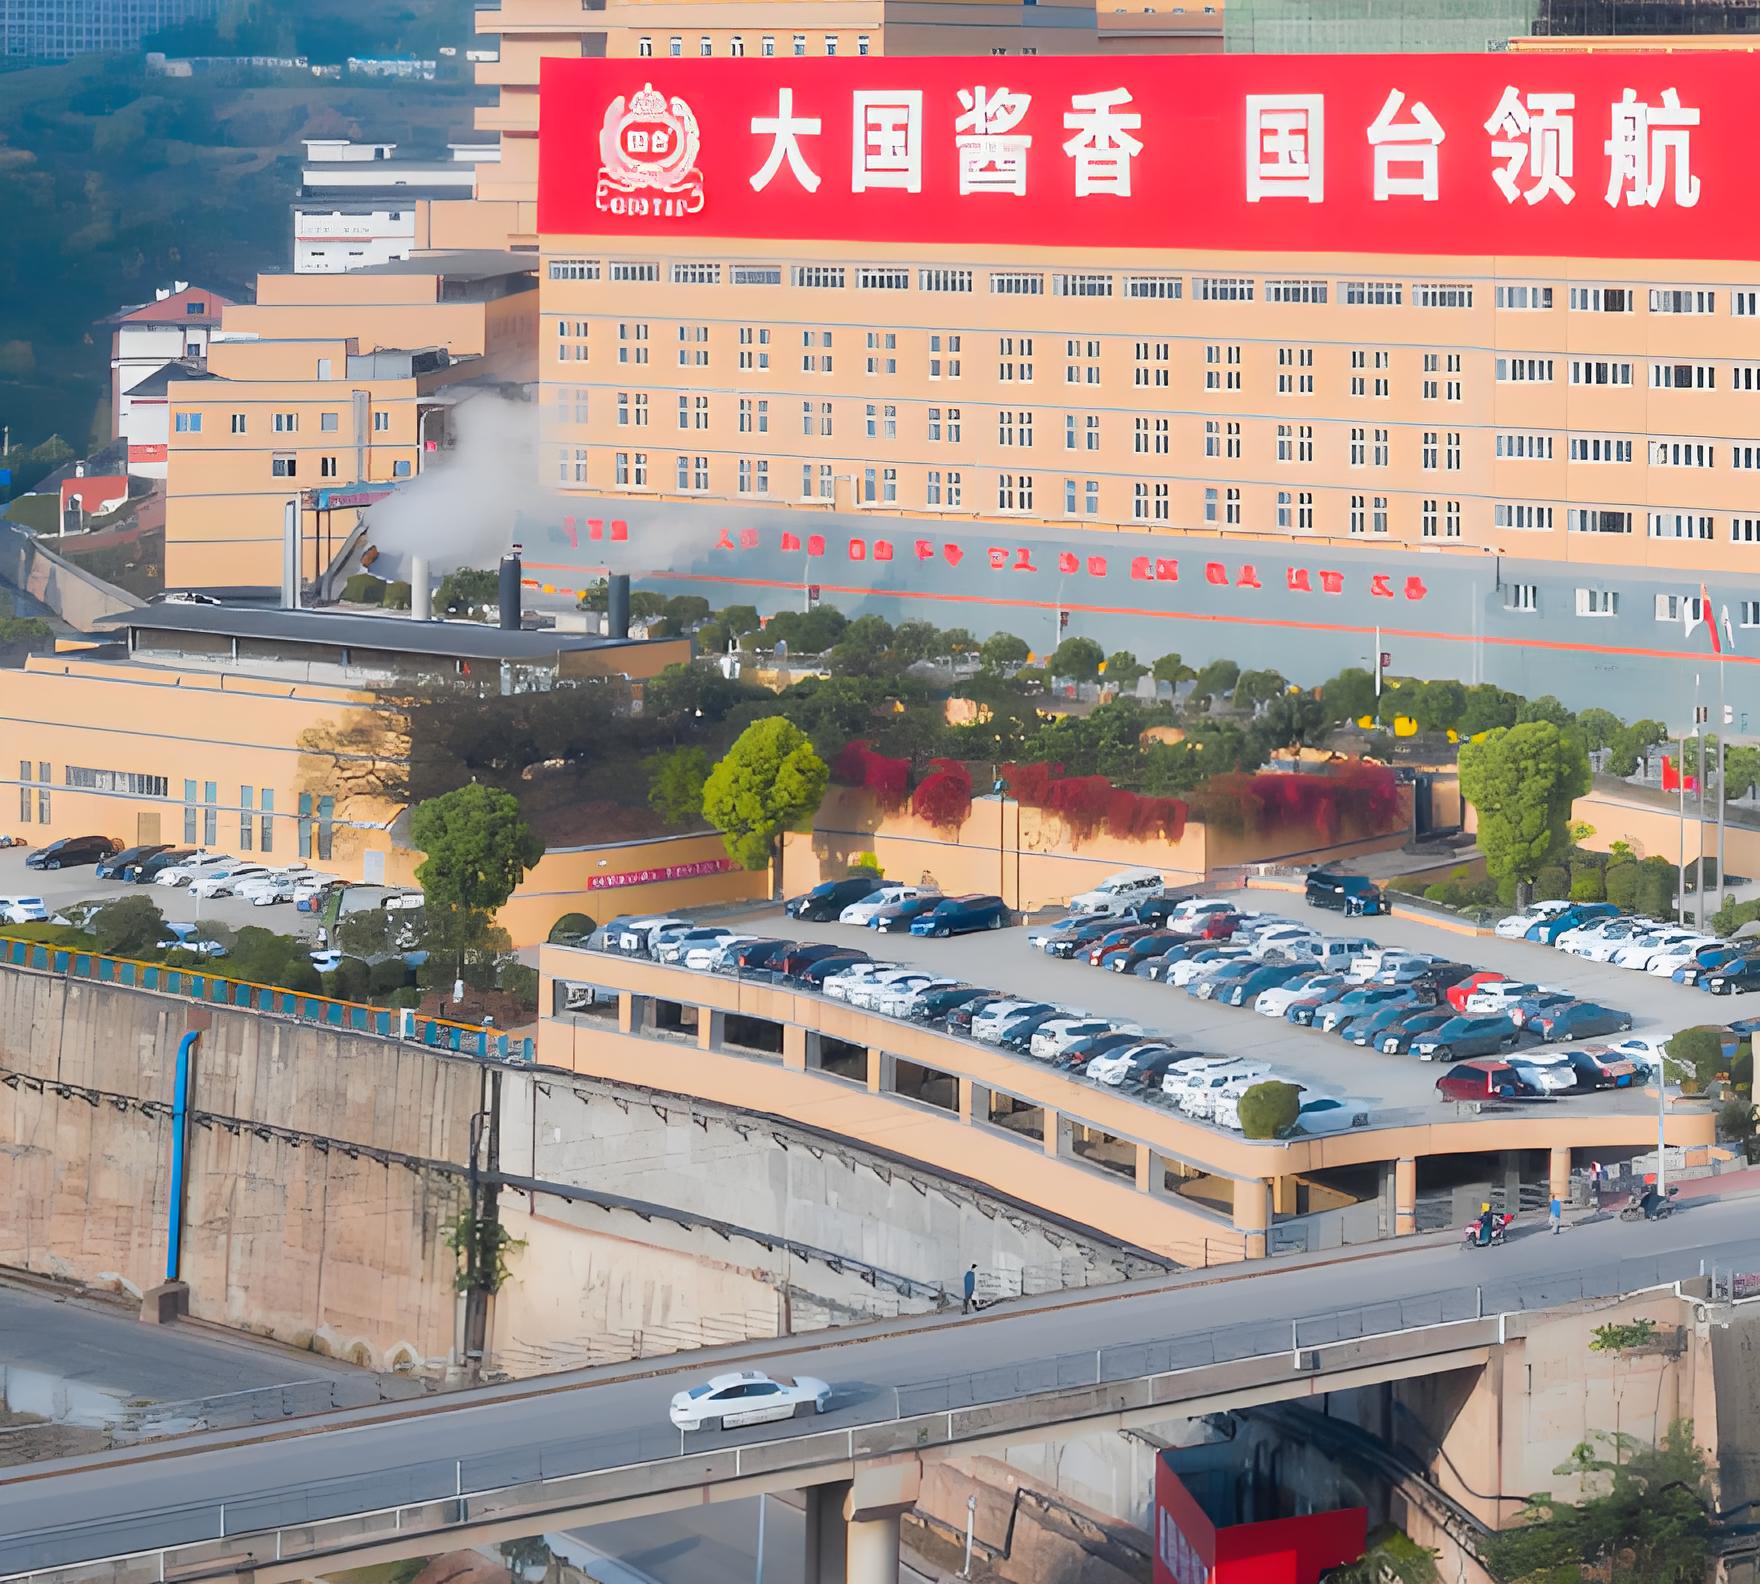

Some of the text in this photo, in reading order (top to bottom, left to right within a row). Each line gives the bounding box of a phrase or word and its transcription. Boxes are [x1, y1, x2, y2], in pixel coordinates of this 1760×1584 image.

[748, 84, 1702, 210] 大国酱香 国台领航
